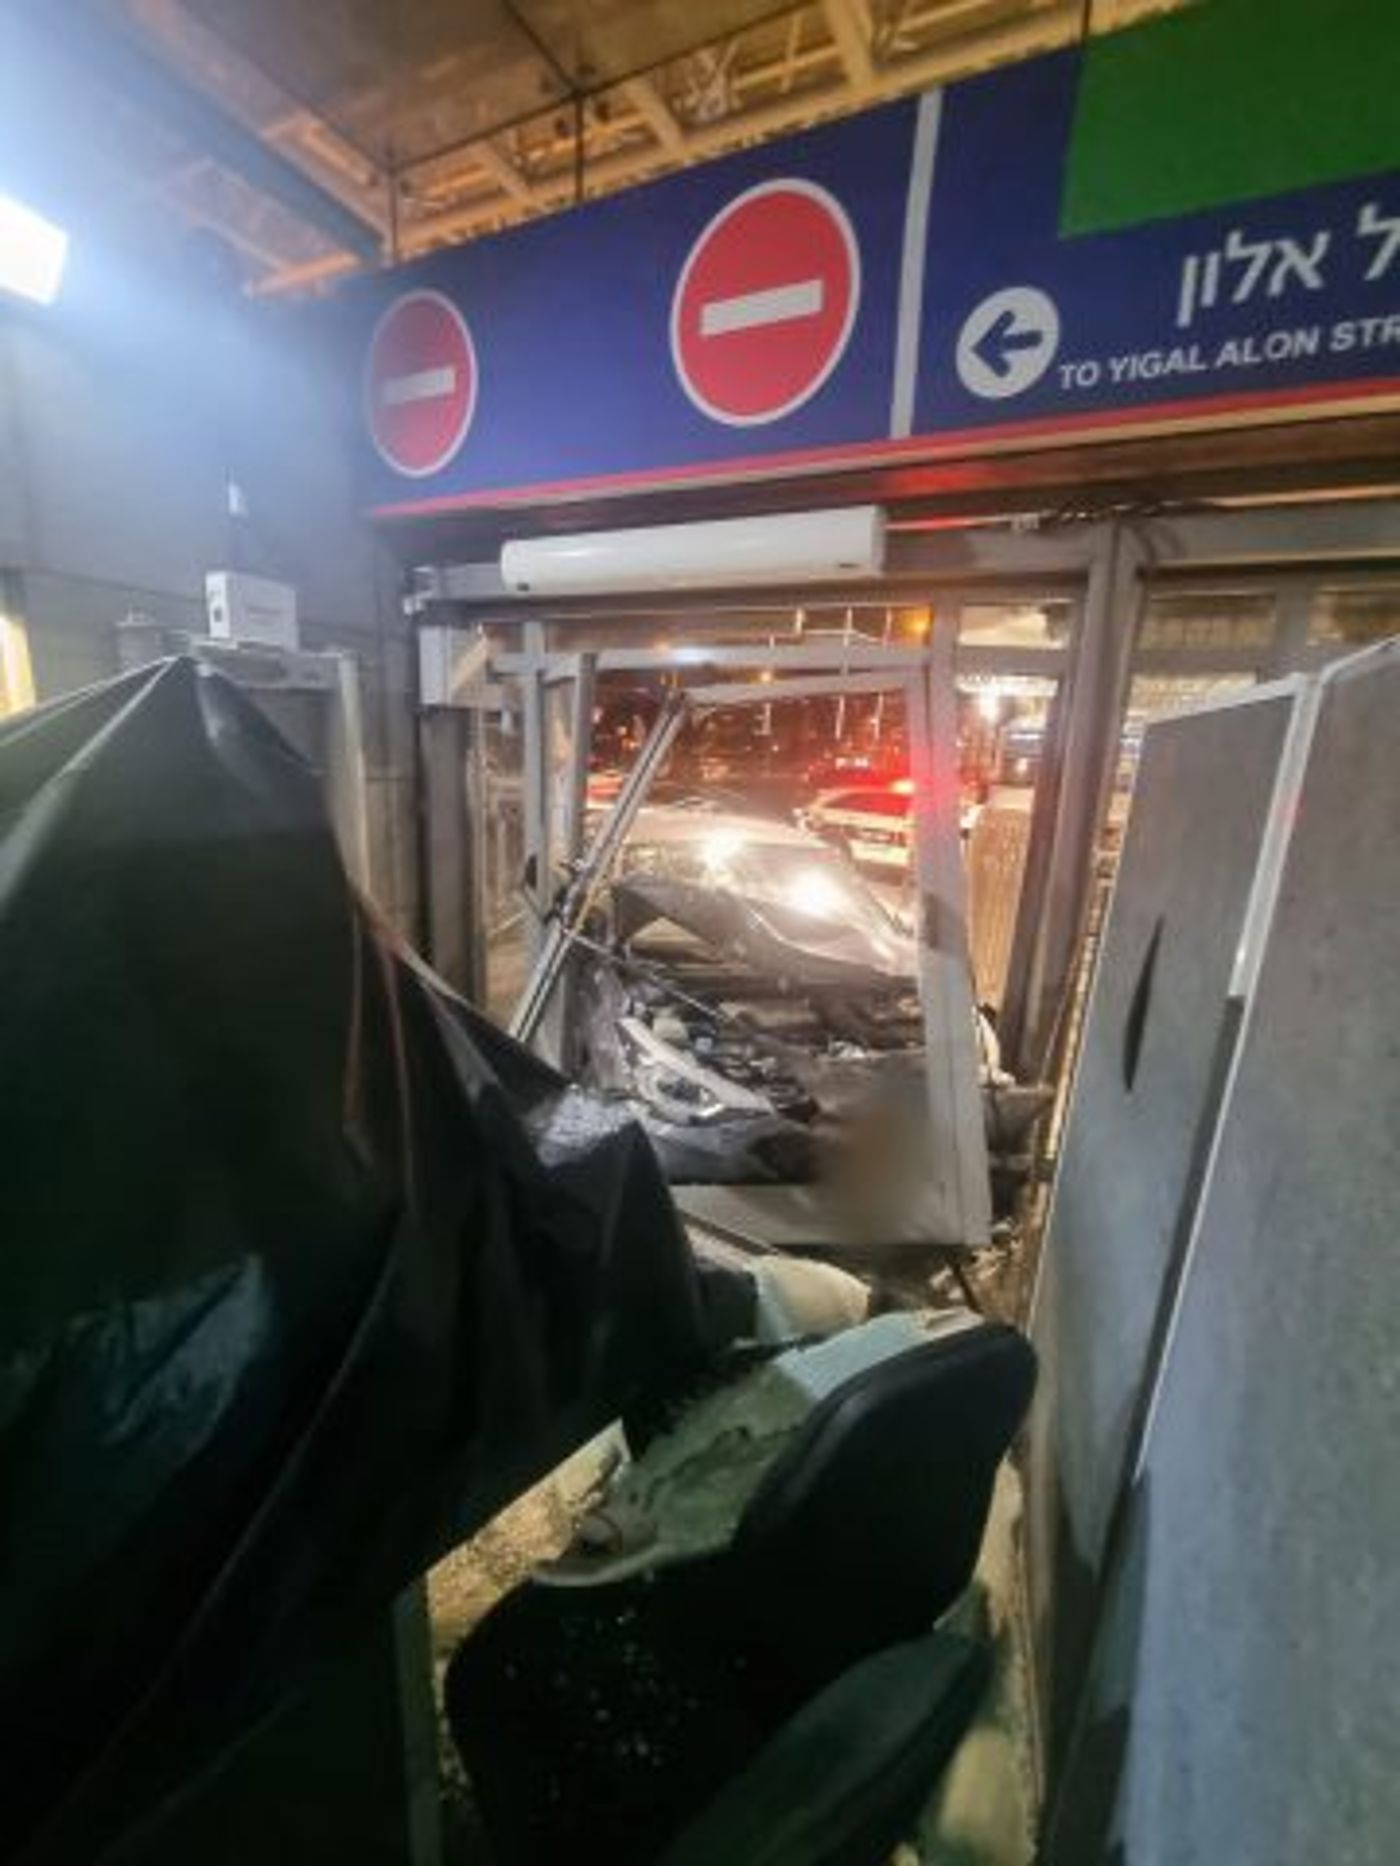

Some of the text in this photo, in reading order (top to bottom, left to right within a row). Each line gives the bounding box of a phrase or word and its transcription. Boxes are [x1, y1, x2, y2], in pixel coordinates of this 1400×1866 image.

[1177, 229, 1331, 328] אלון
[1059, 360, 1099, 390] TO
[1108, 345, 1207, 382] YIGAL
[1216, 326, 1320, 367] ALON
